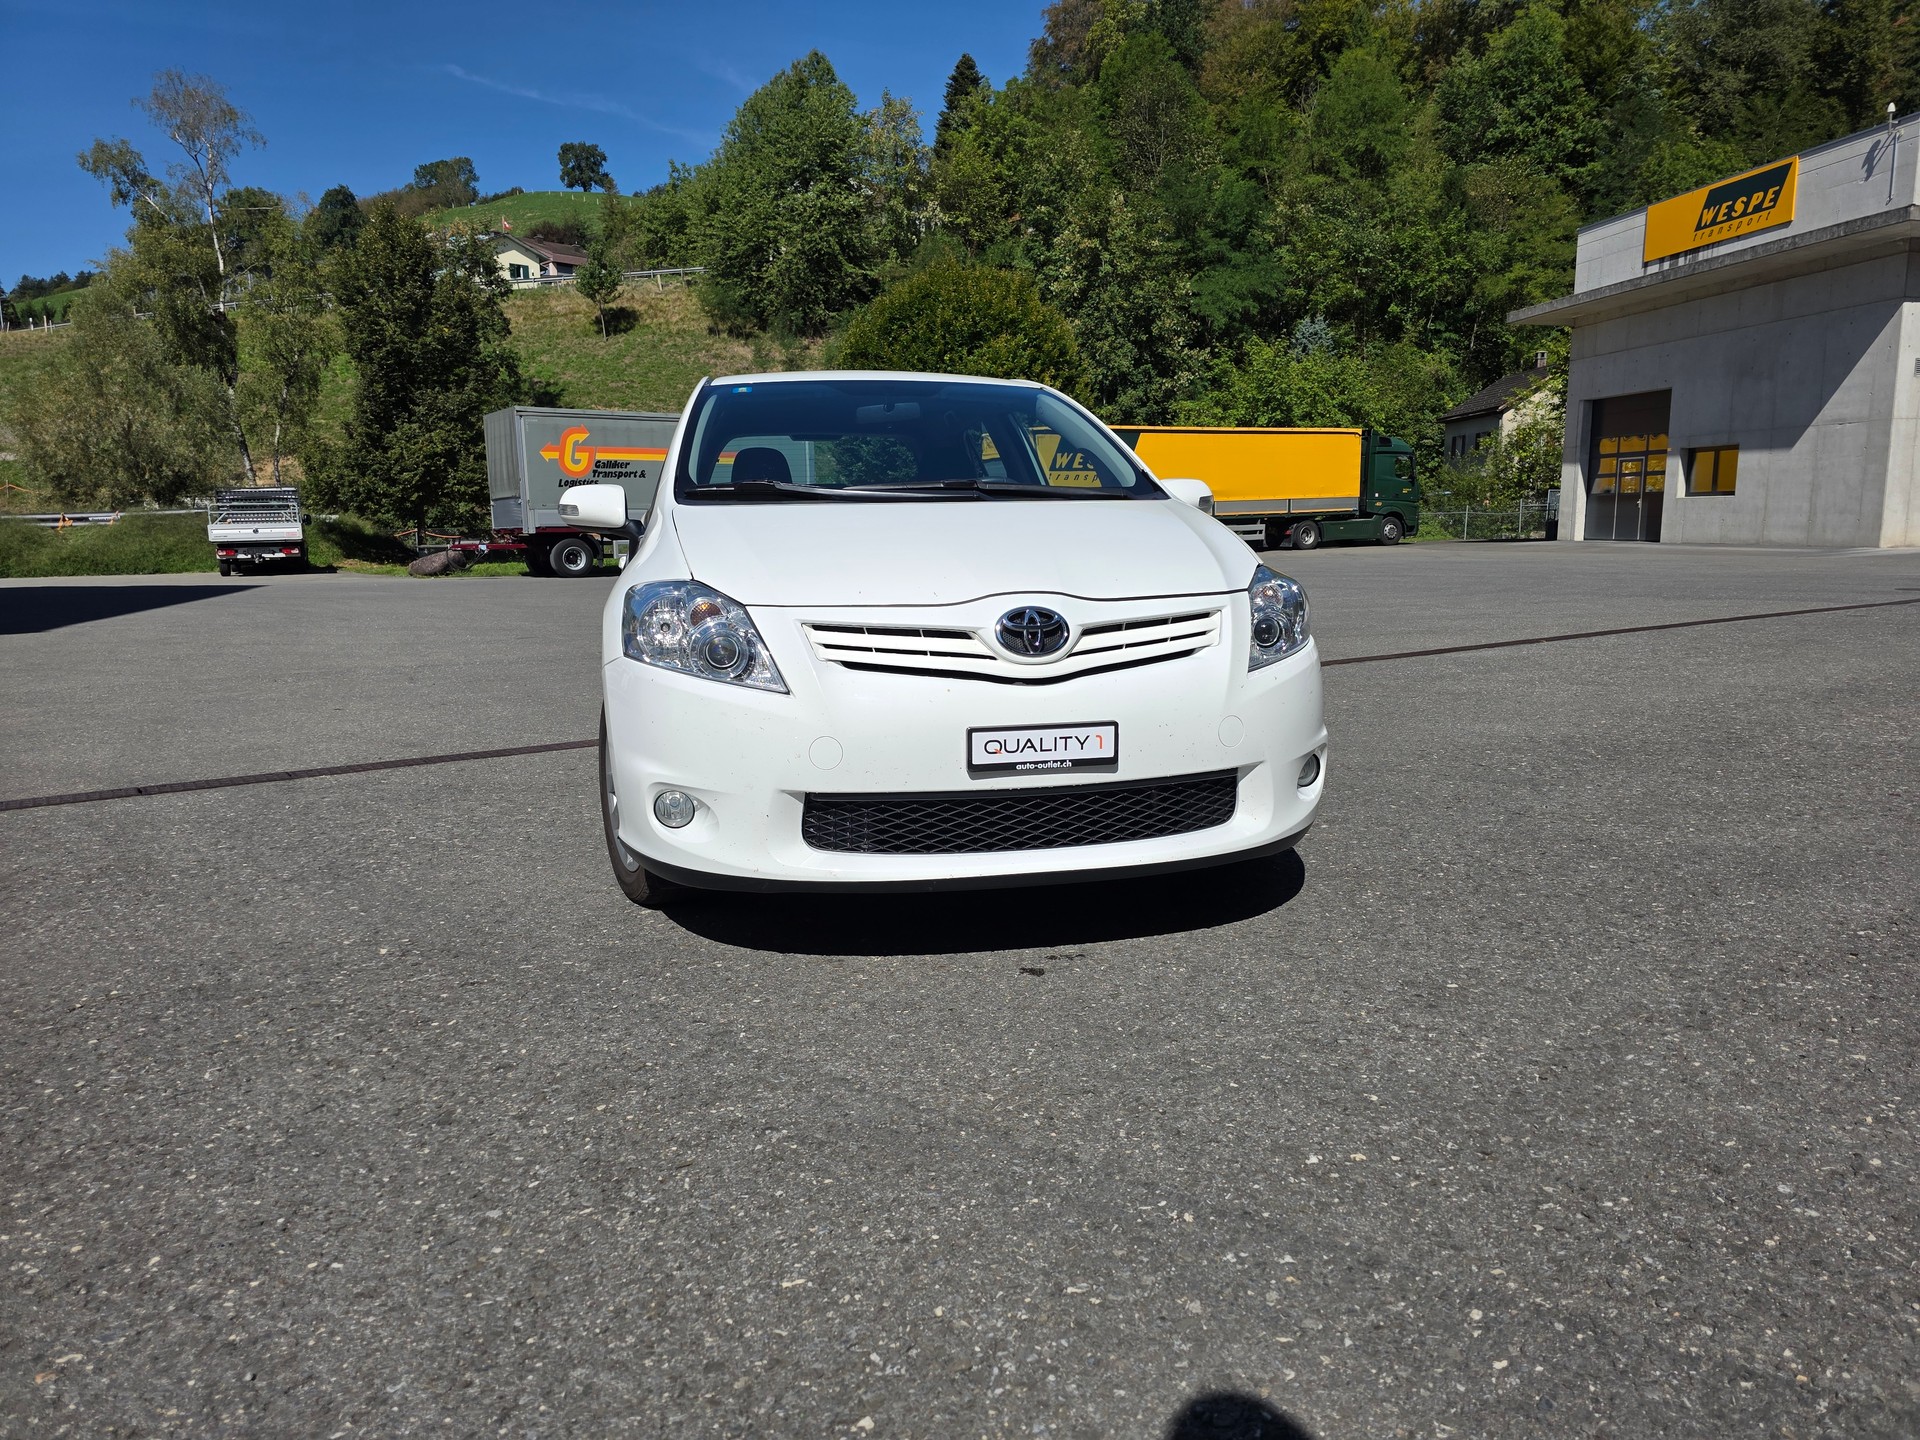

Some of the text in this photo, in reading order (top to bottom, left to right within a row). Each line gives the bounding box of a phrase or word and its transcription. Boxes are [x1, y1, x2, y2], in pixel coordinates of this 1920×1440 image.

[1701, 186, 1780, 227] WESPE
[1693, 211, 1771, 242] transport
[595, 460, 630, 469] Galliker
[592, 469, 646, 479] Transport &
[984, 734, 1103, 754] QUALITY 1
[1016, 760, 1072, 770] auto-outlet.ch
